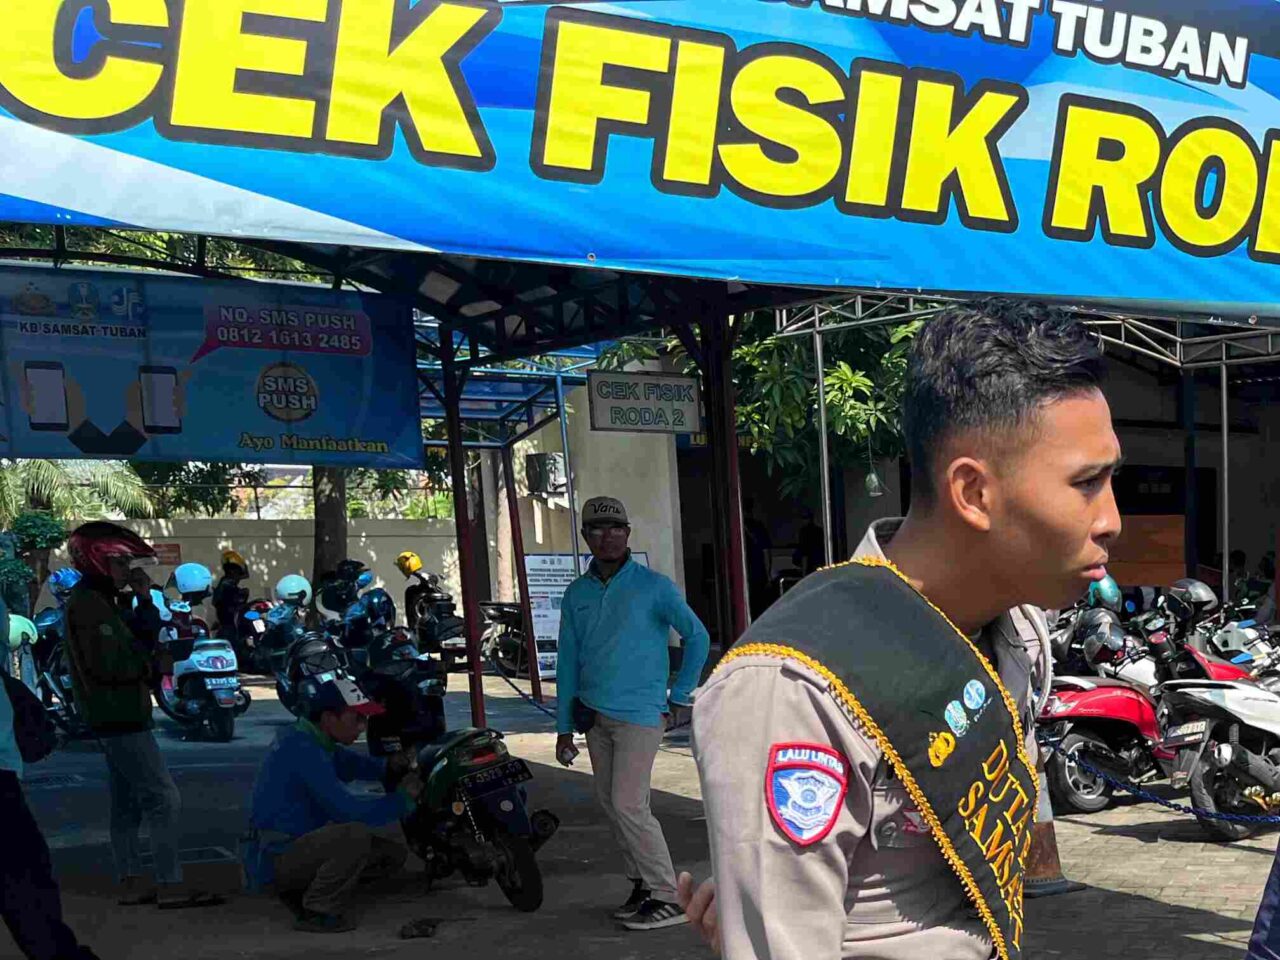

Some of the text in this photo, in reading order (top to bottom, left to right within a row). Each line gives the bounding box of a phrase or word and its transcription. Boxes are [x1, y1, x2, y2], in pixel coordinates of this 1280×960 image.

[1051, 0, 1249, 83] TUBAN
[0, 0, 493, 163] CEK
[541, 20, 1020, 222] FISIK
[219, 306, 357, 331] NO. SMS PUSH
[216, 326, 263, 344] 0812
[269, 330, 313, 347] 1613
[263, 376, 309, 393] SMS
[596, 381, 694, 403] CEK FISIK
[258, 393, 317, 410] PUSH
[610, 406, 685, 427] RODA 2
[239, 431, 390, 454] Ayo Manfaatkan
[982, 738, 1031, 848] DUTA
[958, 781, 1024, 951] SAMSAT
